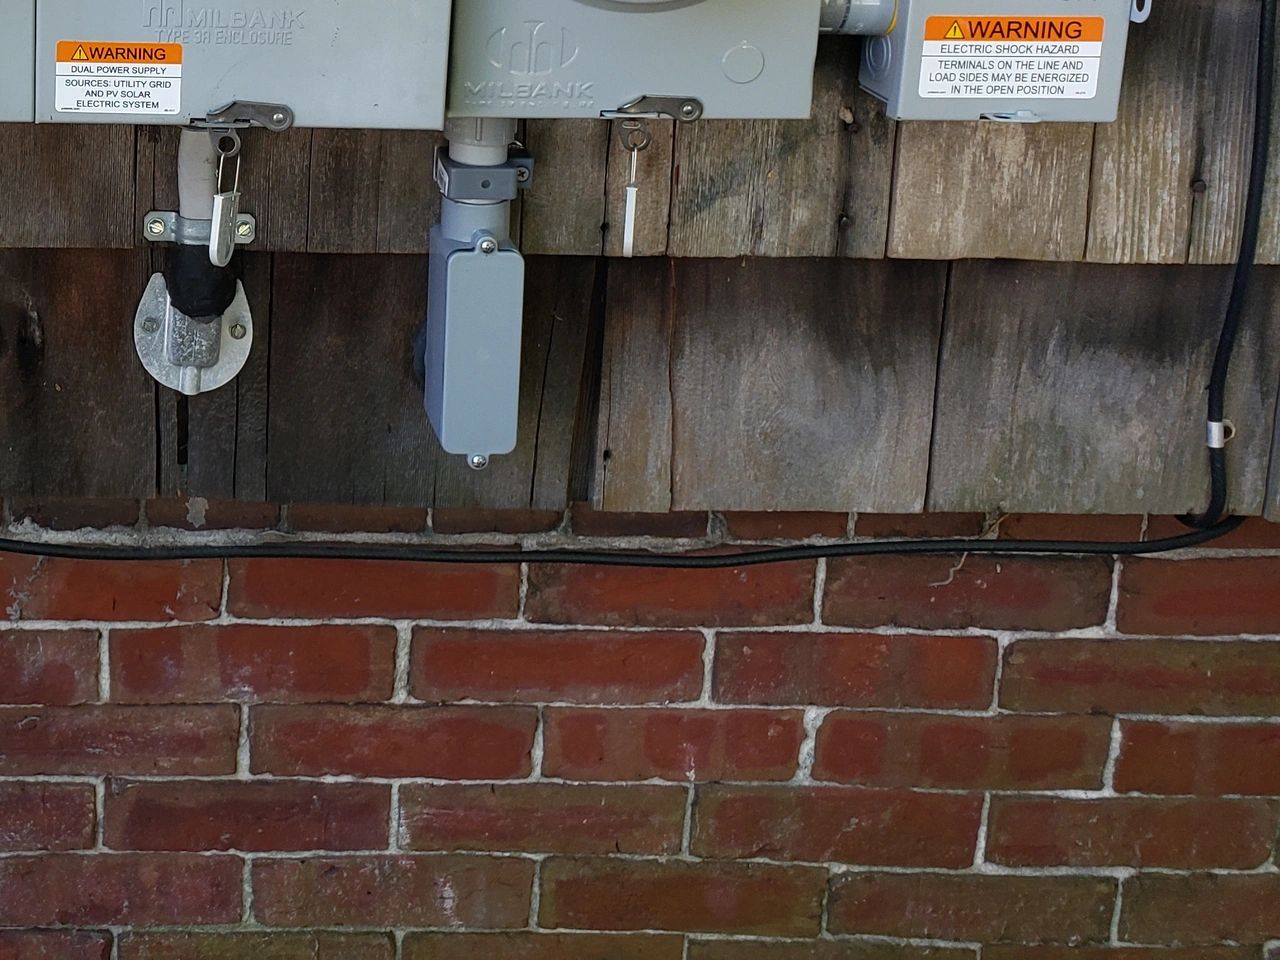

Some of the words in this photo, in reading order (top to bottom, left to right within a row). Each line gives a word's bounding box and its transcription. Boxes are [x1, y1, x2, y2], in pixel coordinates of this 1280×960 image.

[186, 7, 305, 29] MILBANK
[968, 21, 1082, 39] WARNING
[89, 47, 166, 60] WARNING
[940, 45, 992, 53] ELECTRIC
[996, 45, 1033, 54] SHOCK
[1036, 45, 1079, 54] HAZARD
[938, 60, 994, 70] TERMINALS
[998, 61, 1012, 69] ON
[1021, 61, 1035, 70] THE
[1038, 61, 1059, 70] LINE
[1062, 61, 1083, 70] AND
[96, 66, 130, 74] POWER
[929, 73, 955, 82] LOAD
[959, 73, 988, 82] SIDES
[991, 74, 1012, 82] MAY
[1015, 74, 1027, 82] BE
[1031, 74, 1089, 83] ENERGIZED
[65, 79, 111, 87] SOURCES:
[114, 80, 147, 88] UTILITY
[951, 86, 961, 94] IN
[964, 86, 983, 94] THE
[986, 86, 1014, 94] OPEN
[1017, 86, 1064, 95] POSITION
[76, 100, 120, 108] ELECTRIC
